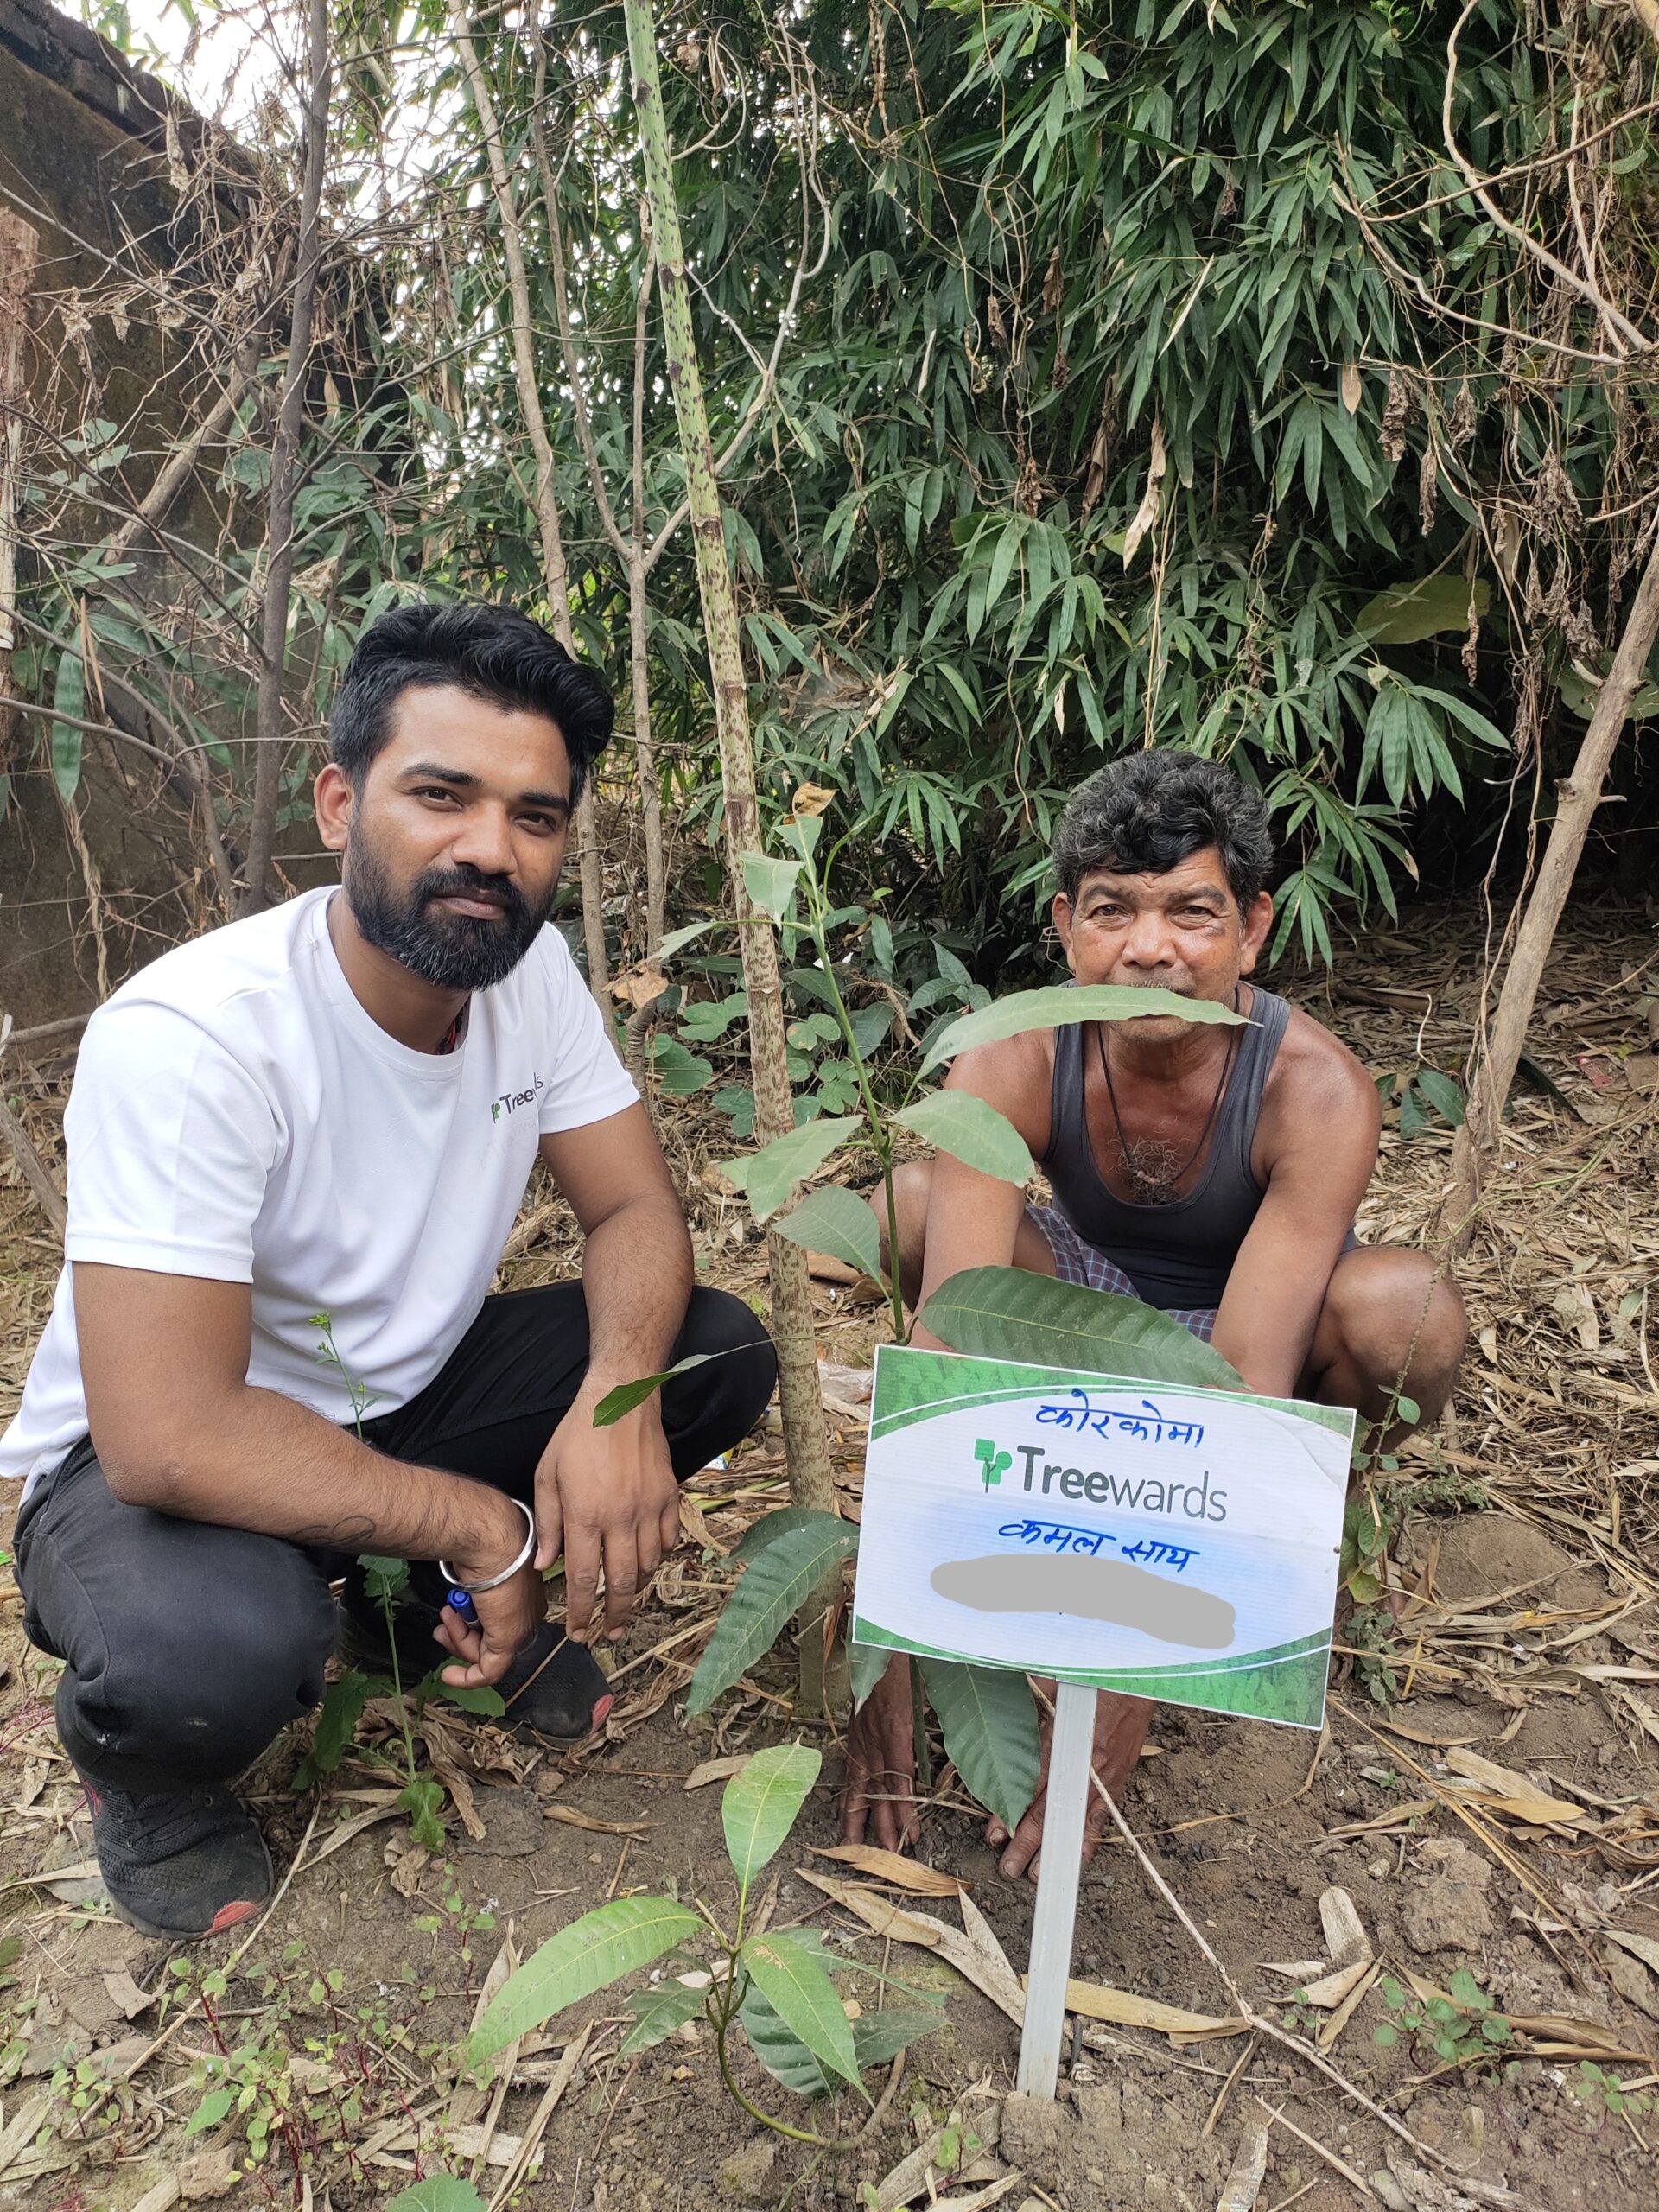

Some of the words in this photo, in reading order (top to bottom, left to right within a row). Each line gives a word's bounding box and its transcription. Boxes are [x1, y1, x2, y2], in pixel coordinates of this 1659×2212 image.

[499, 1072, 543, 1115] Trees
[1016, 1445, 1228, 1522] Treewards
[998, 1519, 1116, 1555] कमल
